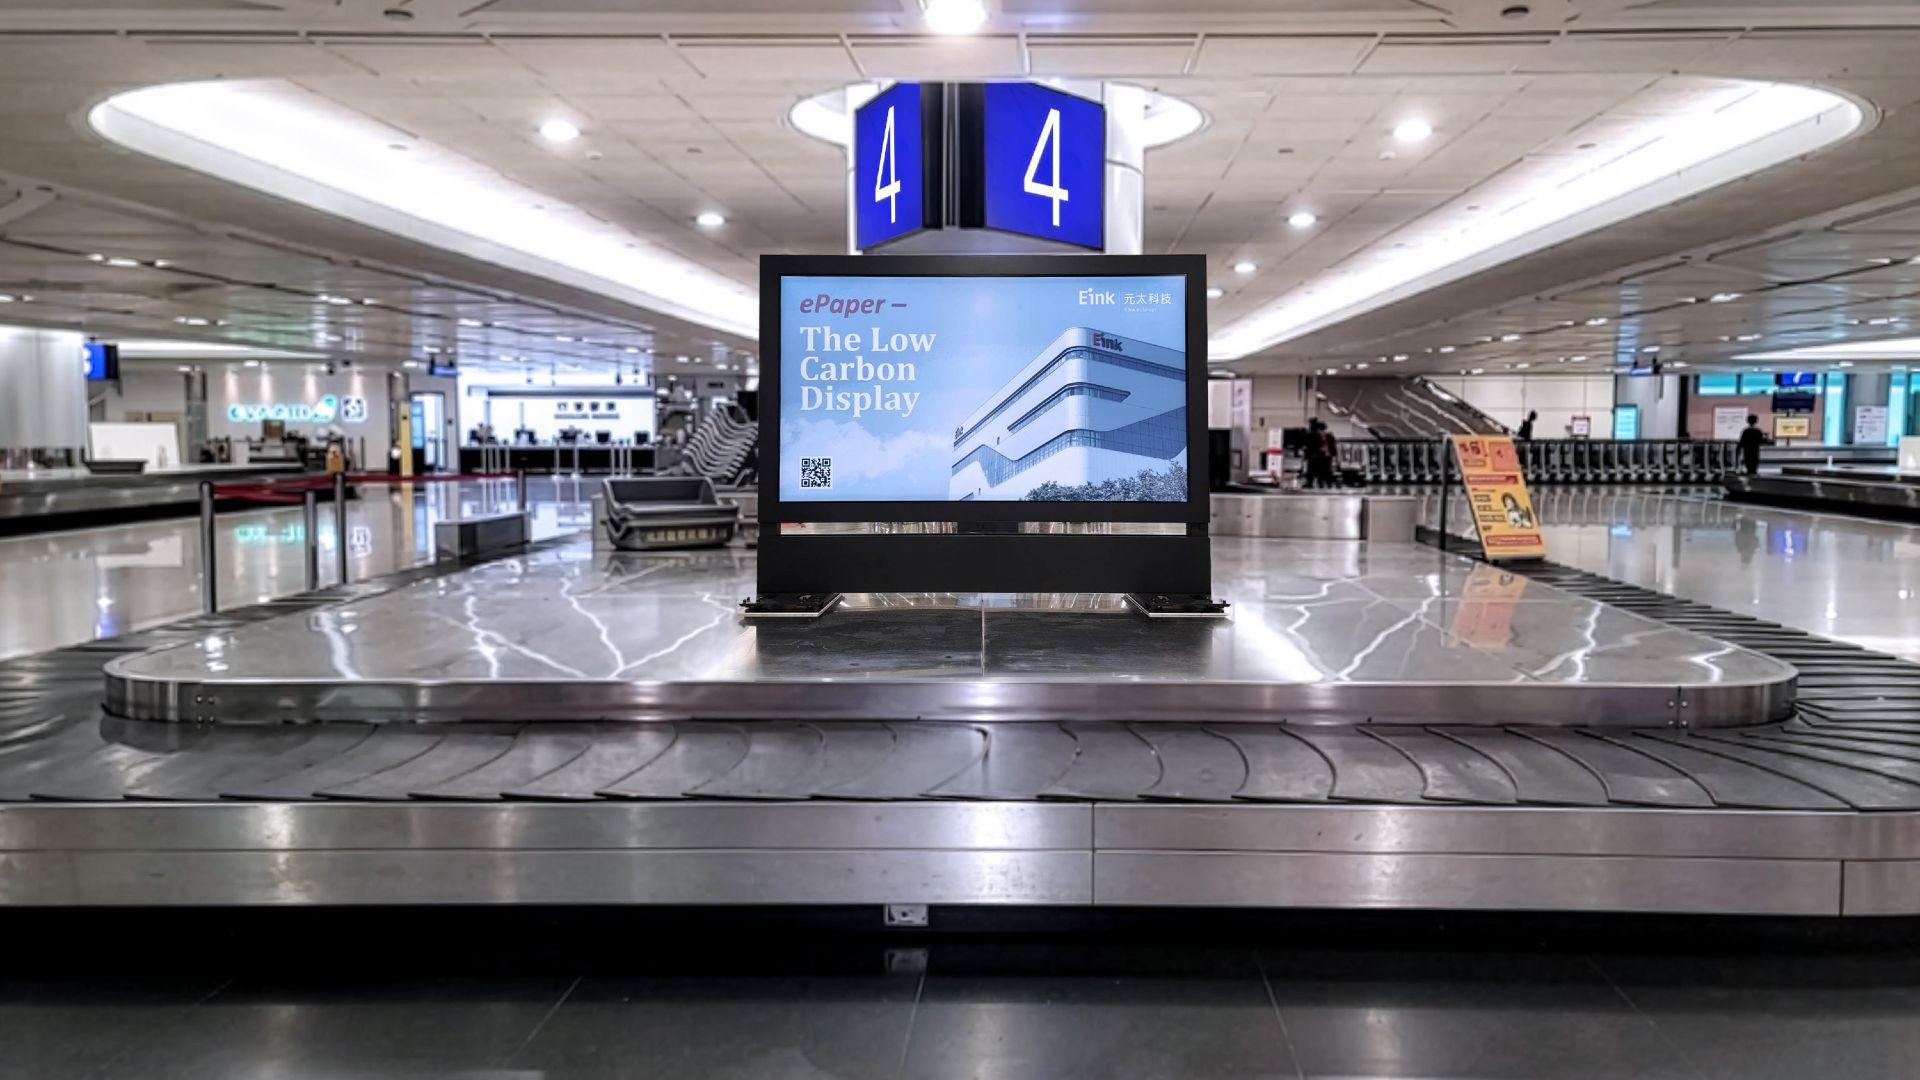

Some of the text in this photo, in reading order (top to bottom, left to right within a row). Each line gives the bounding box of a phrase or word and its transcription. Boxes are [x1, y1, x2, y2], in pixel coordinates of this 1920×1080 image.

[875, 105, 901, 224] 4
[1024, 108, 1069, 227] 4
[799, 294, 886, 318] ePaper
[1123, 293, 1172, 305] 元太科技
[799, 326, 937, 352] The Low
[800, 355, 916, 381] Carbon
[799, 384, 921, 418] Display
